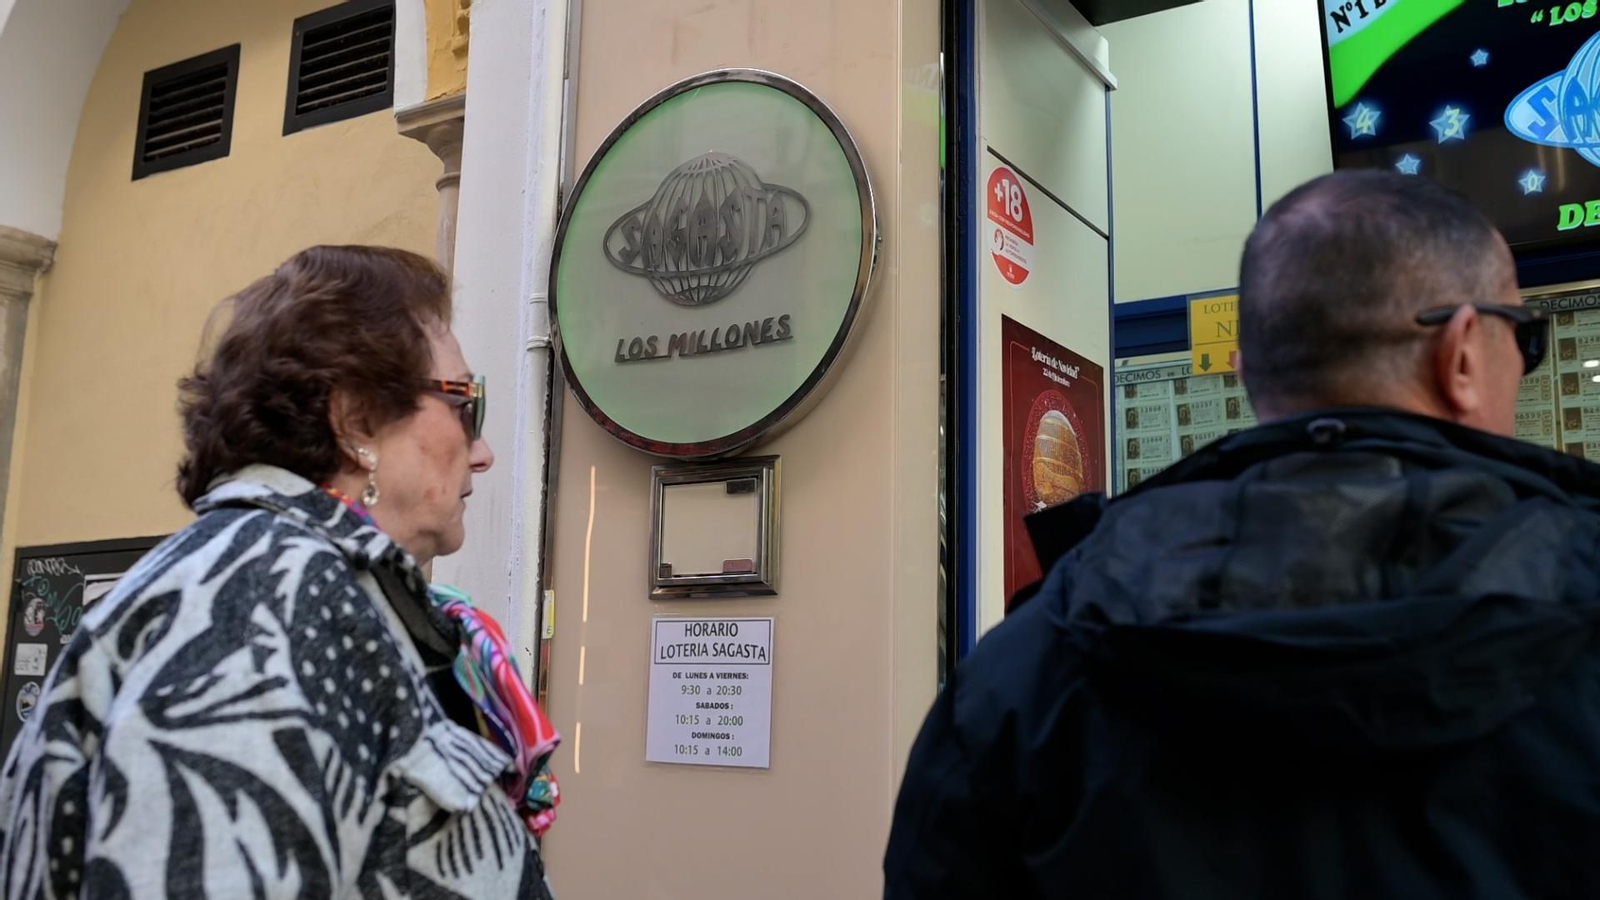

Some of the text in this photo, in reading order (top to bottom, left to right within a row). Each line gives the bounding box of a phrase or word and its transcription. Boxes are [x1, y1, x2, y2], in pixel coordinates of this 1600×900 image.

[1549, 0, 1597, 26] LOS
[1355, 107, 1371, 134] 4
[1443, 108, 1461, 136] 3
[994, 178, 1023, 222] +18
[618, 186, 788, 271] SAGASTA
[615, 313, 793, 363] LOS MILLONES
[685, 622, 738, 637] HORARIO
[660, 642, 766, 662] LOTERIA SAGASTA
[716, 672, 749, 680] VIERNES:
[681, 684, 742, 696] 9:30 a 20:30
[675, 714, 744, 726] 10:15 a 20:00
[674, 744, 743, 757] 10:15 a 14:00
